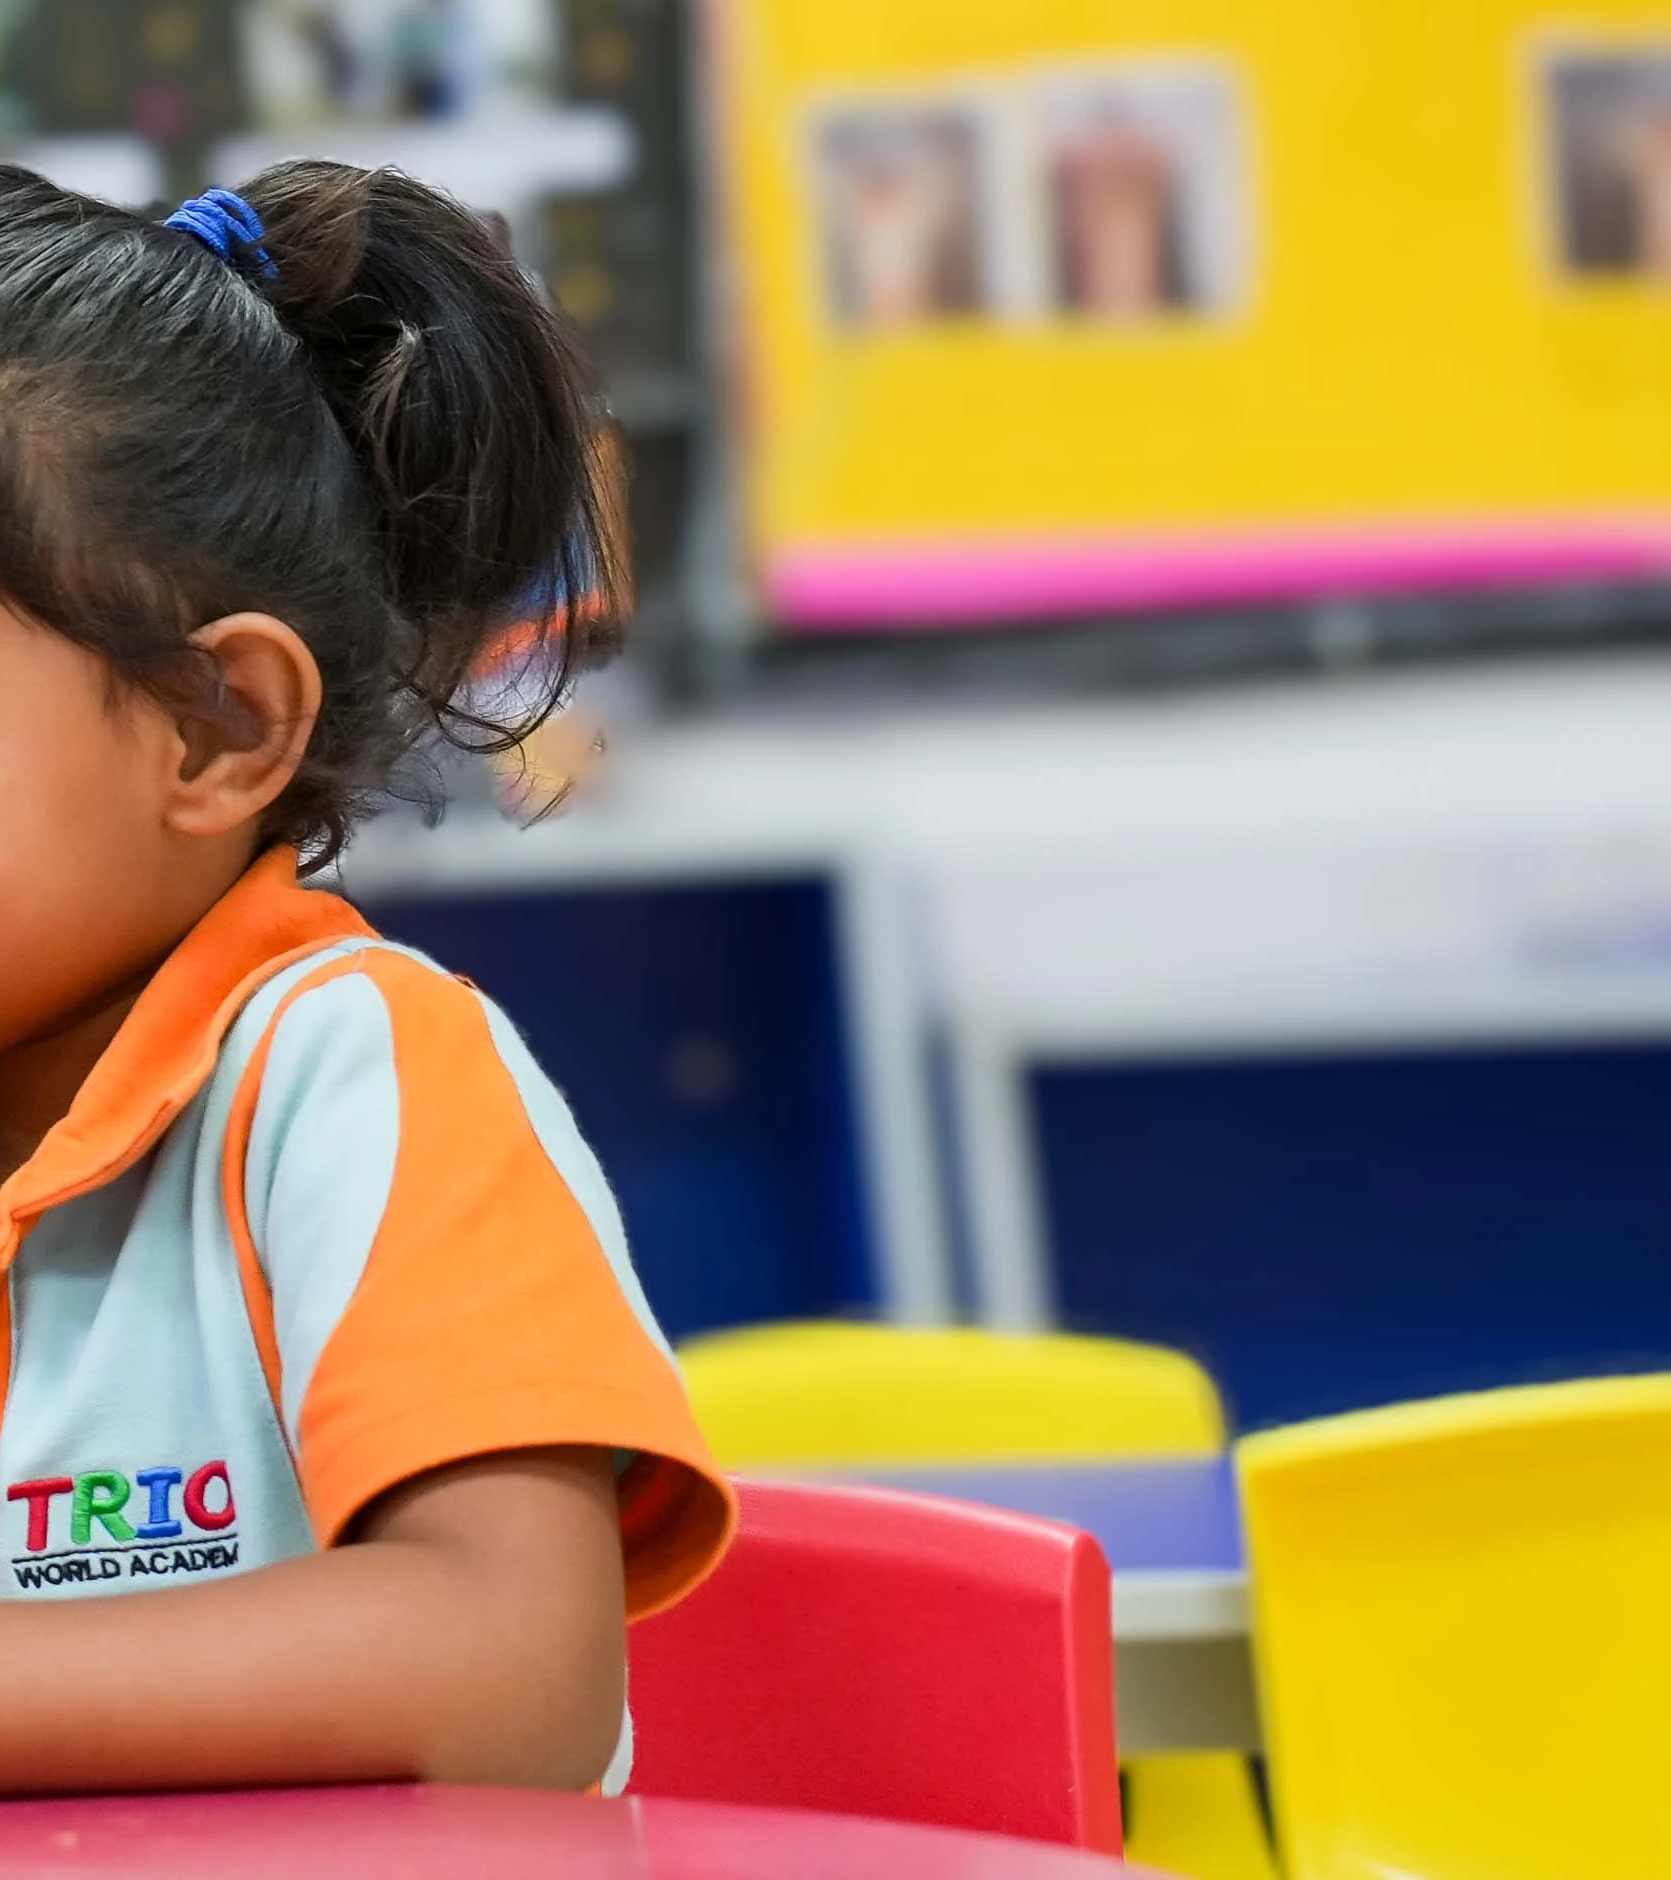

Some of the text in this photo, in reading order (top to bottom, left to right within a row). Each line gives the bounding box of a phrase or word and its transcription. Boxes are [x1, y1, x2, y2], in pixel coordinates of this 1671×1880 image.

[7, 1459, 236, 1552] TRIO
[13, 1541, 239, 1589] WORLD ACADEM
